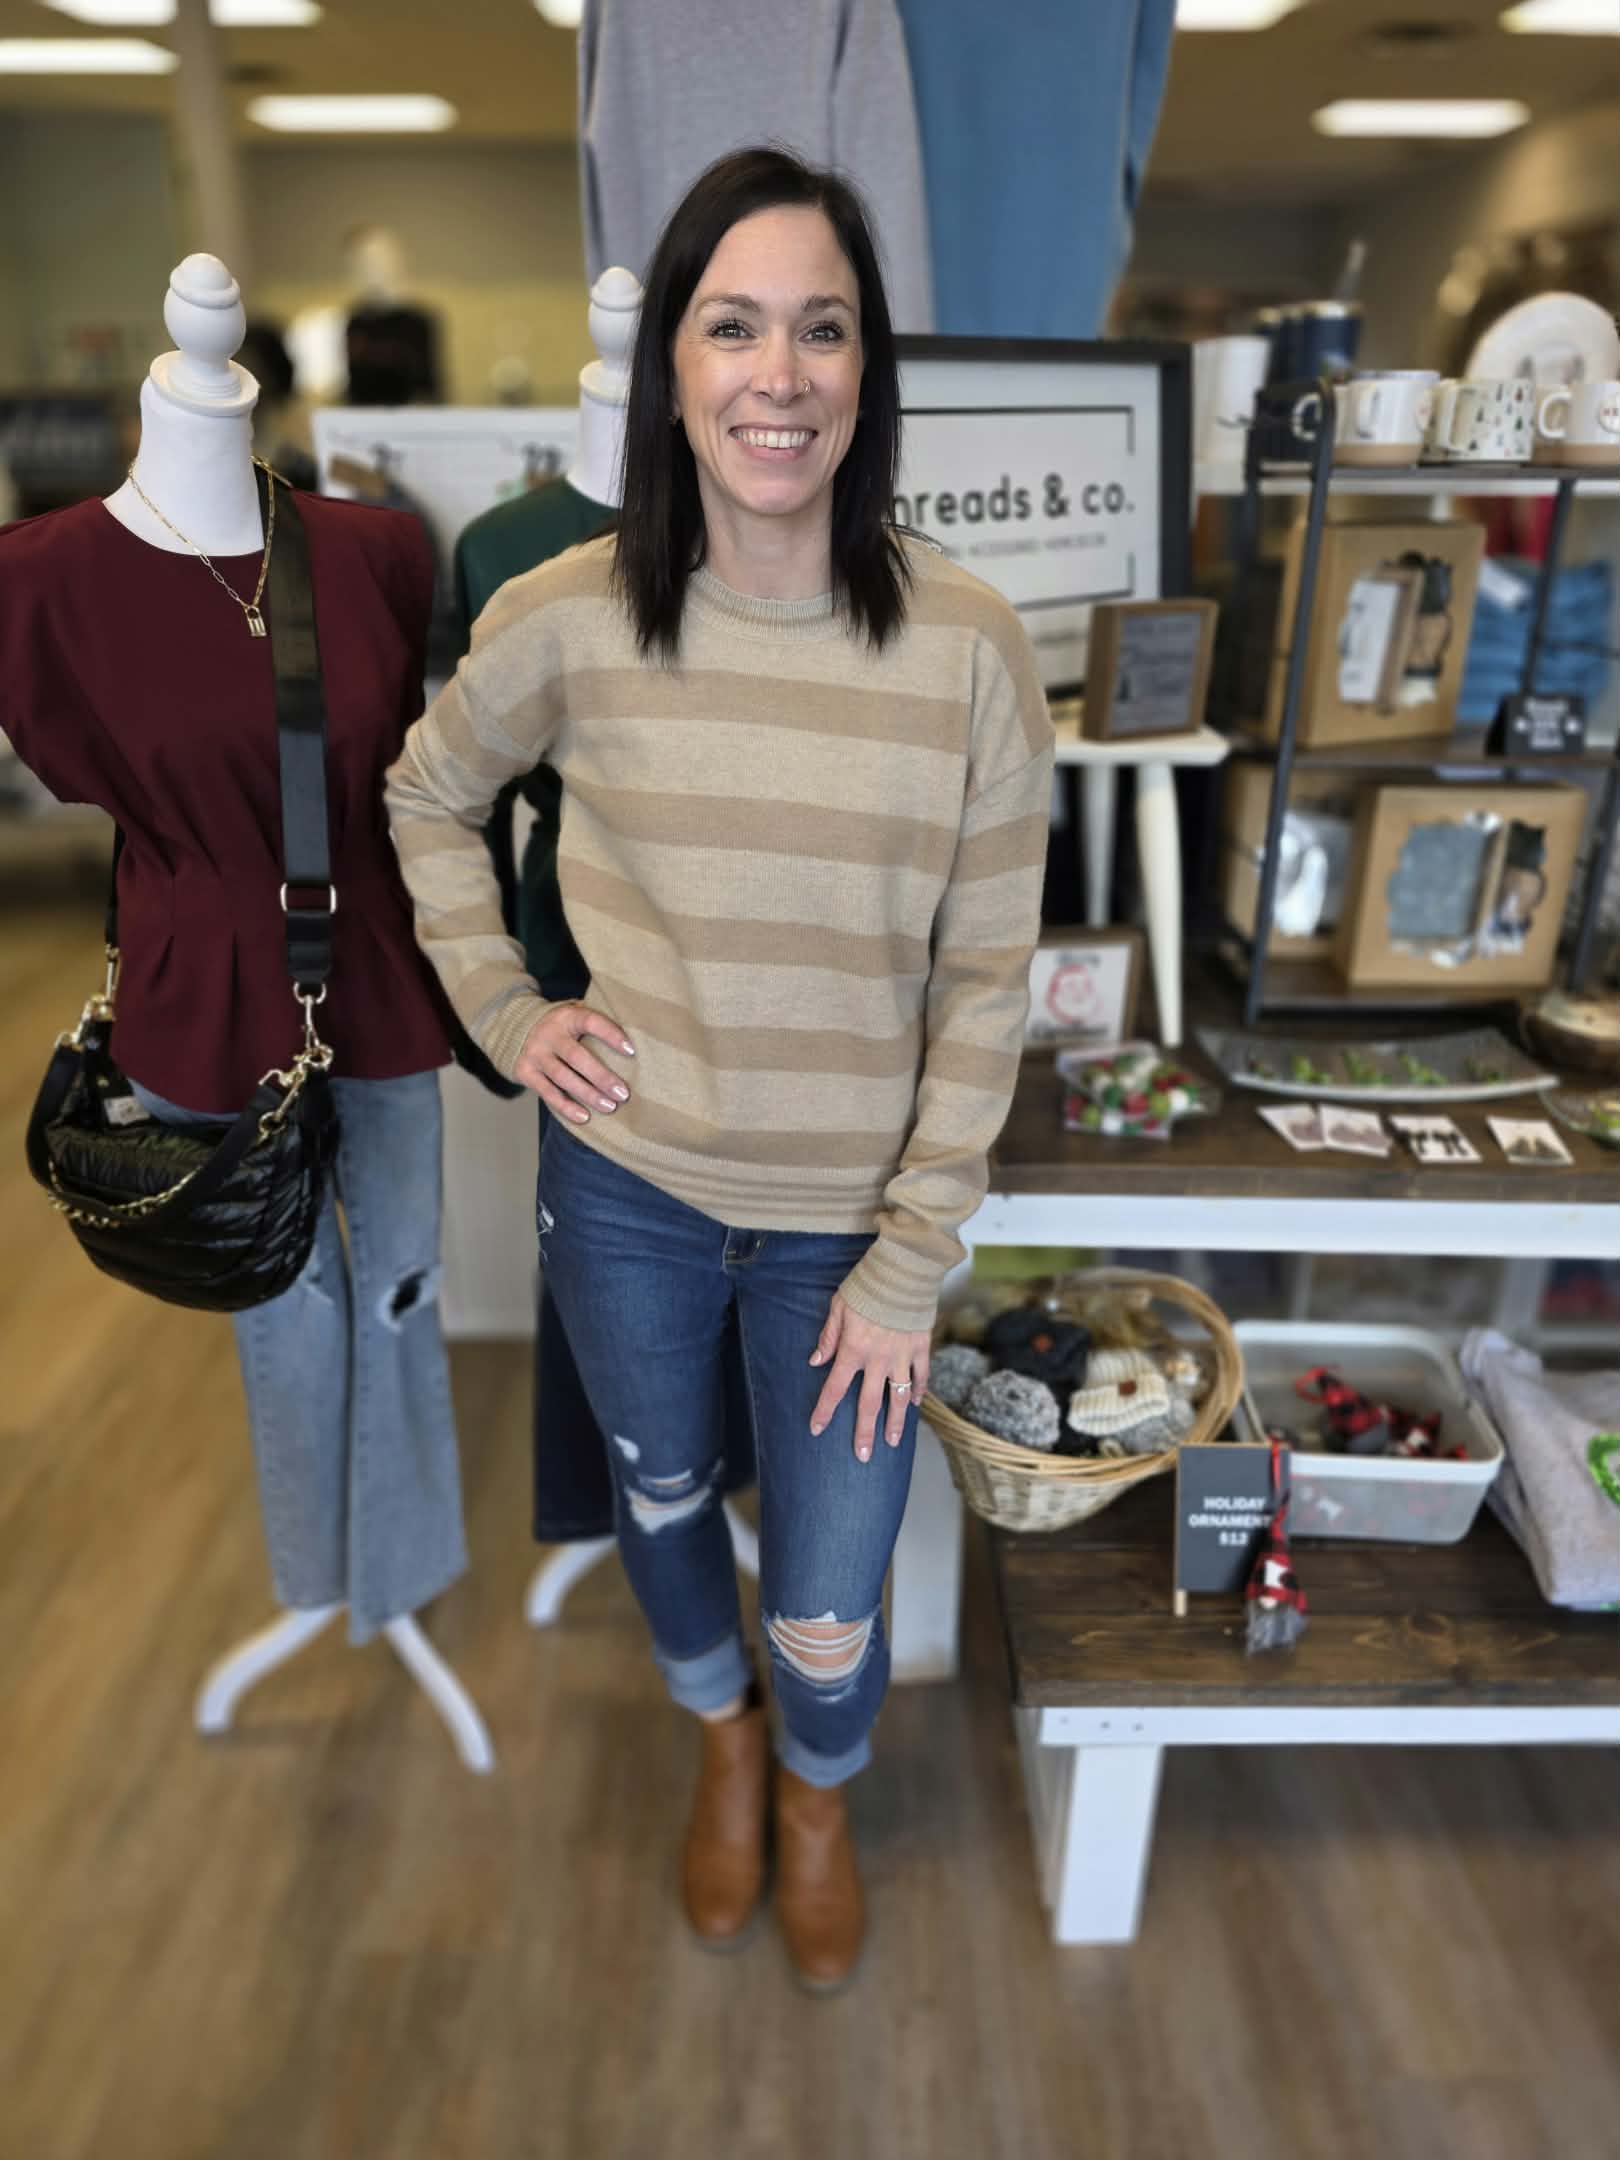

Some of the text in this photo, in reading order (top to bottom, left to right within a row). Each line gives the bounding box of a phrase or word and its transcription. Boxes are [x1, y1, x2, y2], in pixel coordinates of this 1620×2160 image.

[1043, 472, 1068, 518] &
[1081, 482, 1135, 515] co.
[1203, 1496, 1266, 1510] HOLIDAY
